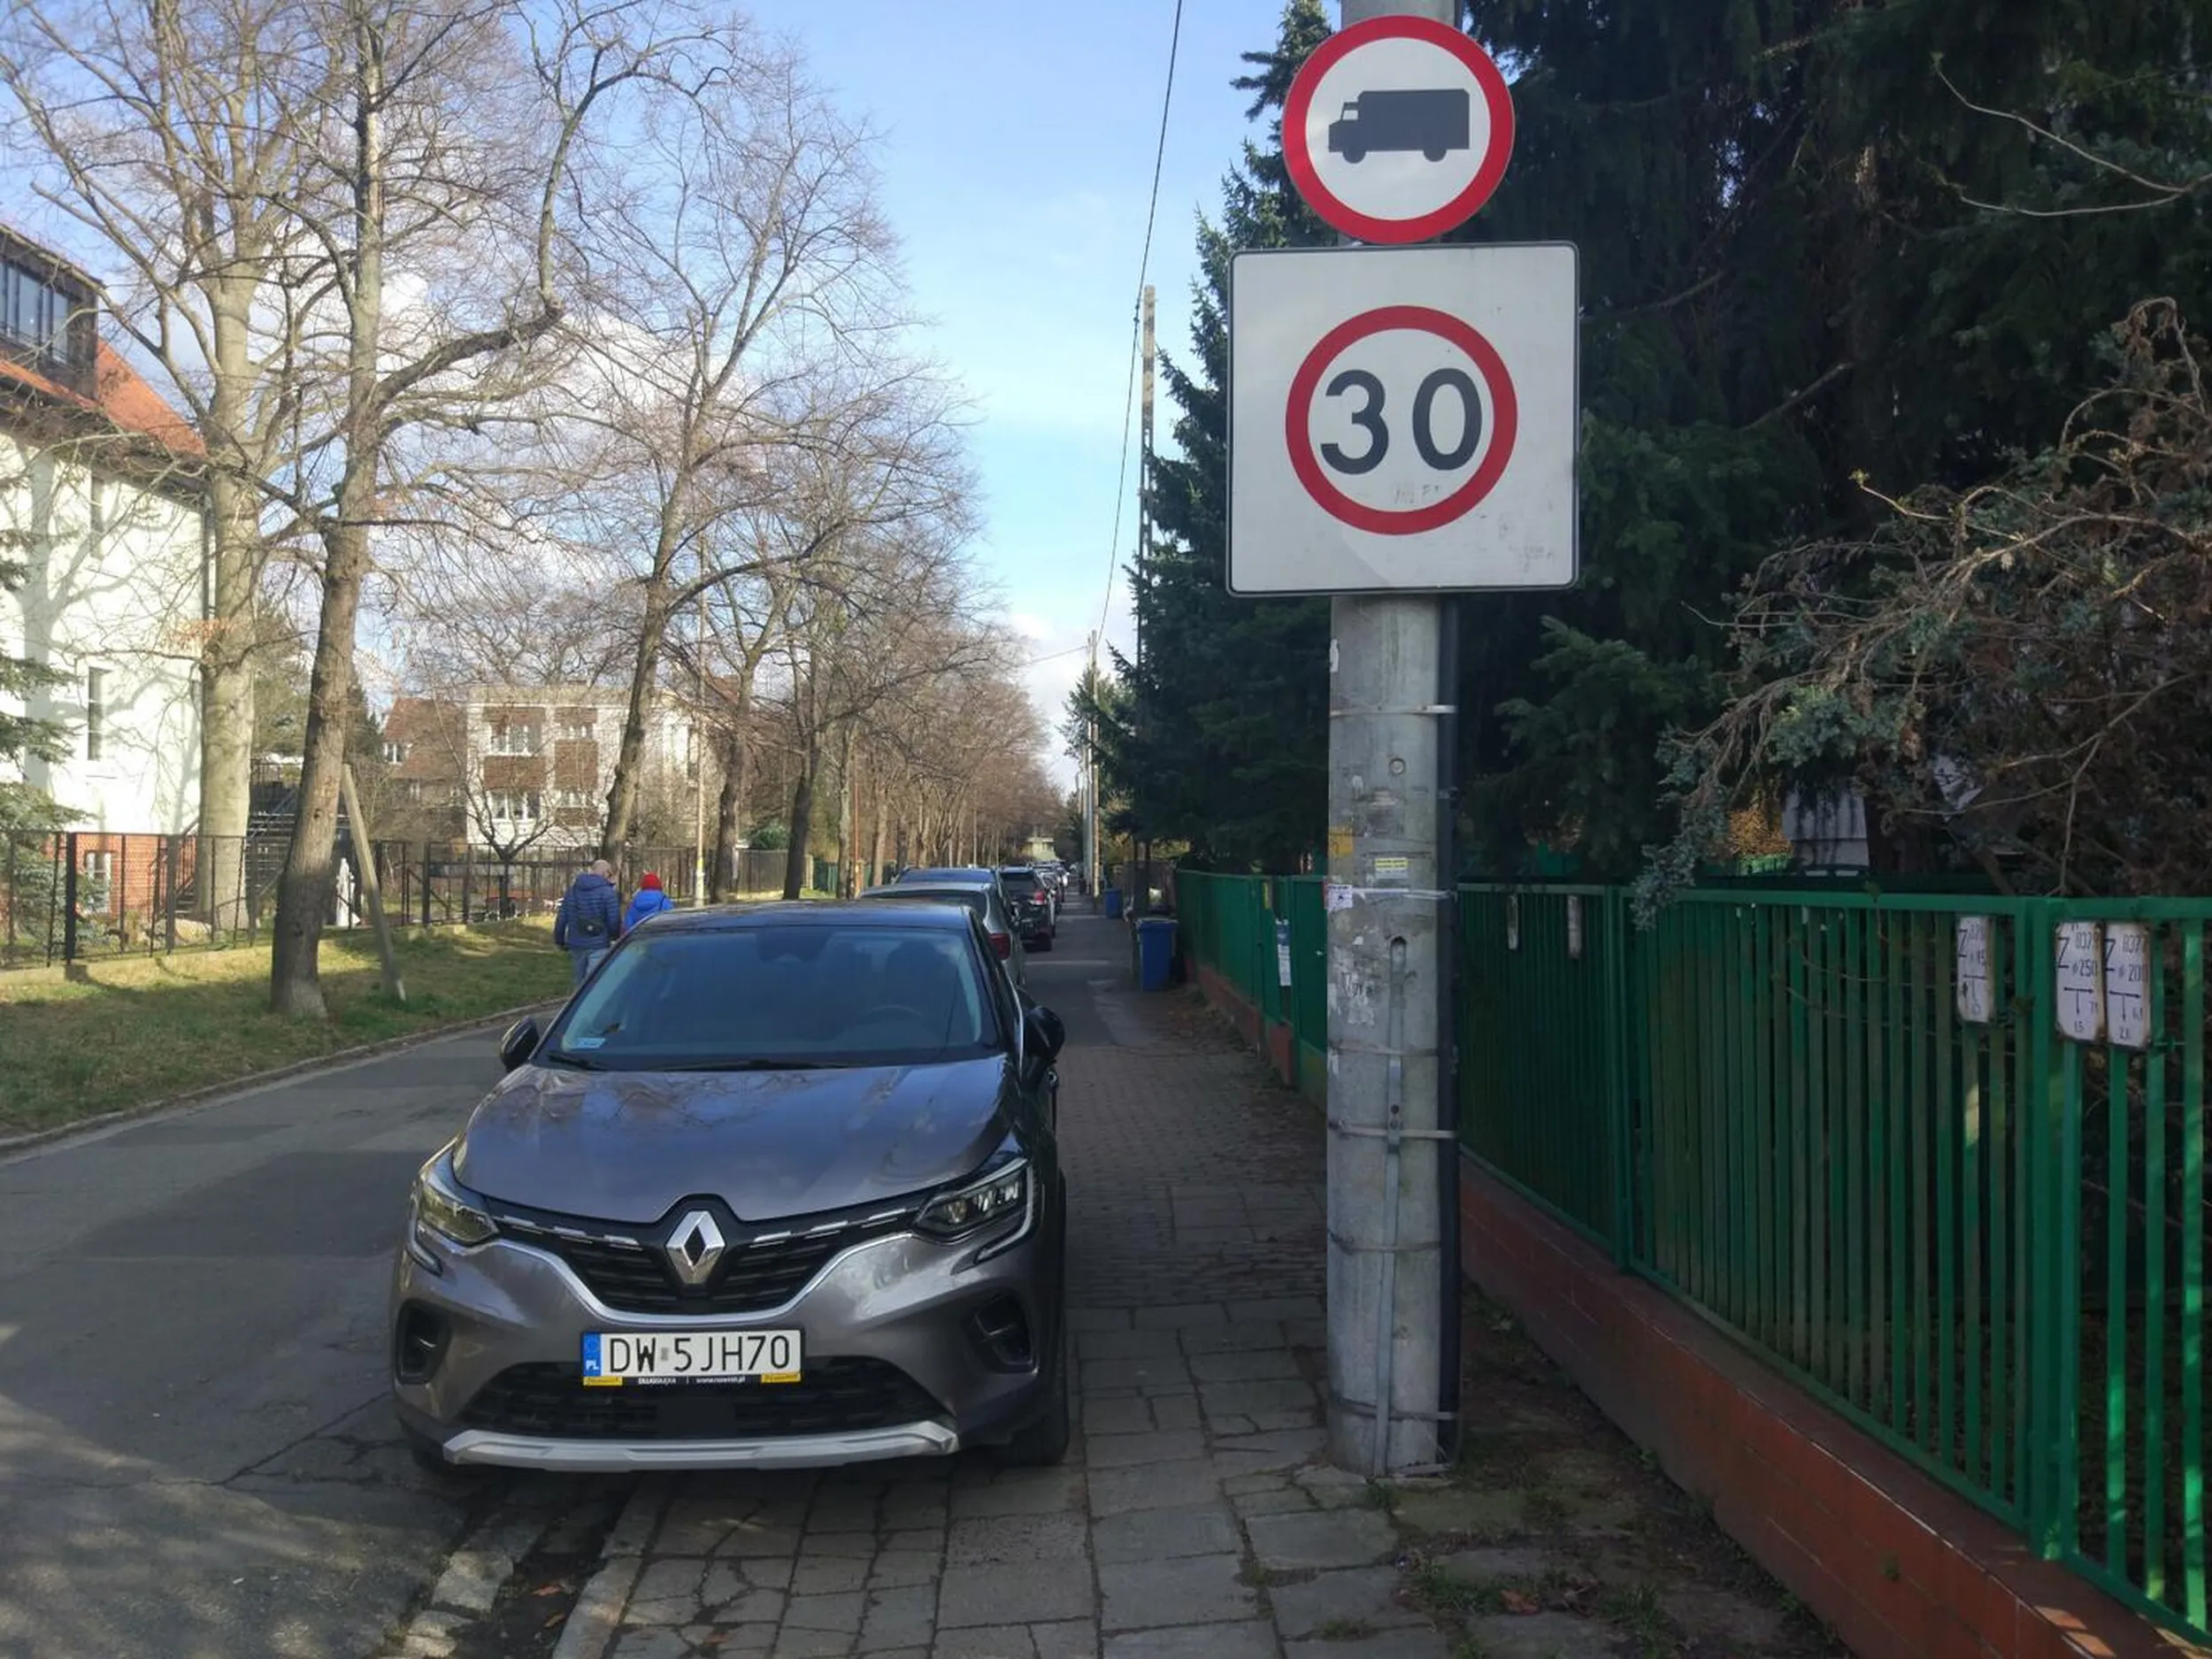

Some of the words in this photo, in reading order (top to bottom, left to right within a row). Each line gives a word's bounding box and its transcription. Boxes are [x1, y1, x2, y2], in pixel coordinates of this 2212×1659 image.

[1320, 368, 1483, 475] 30
[2057, 937, 2070, 968] Z
[2105, 938, 2116, 972] Z
[586, 1359, 599, 1371] PL
[610, 1337, 656, 1372] DW
[674, 1335, 789, 1372] 5JH70
